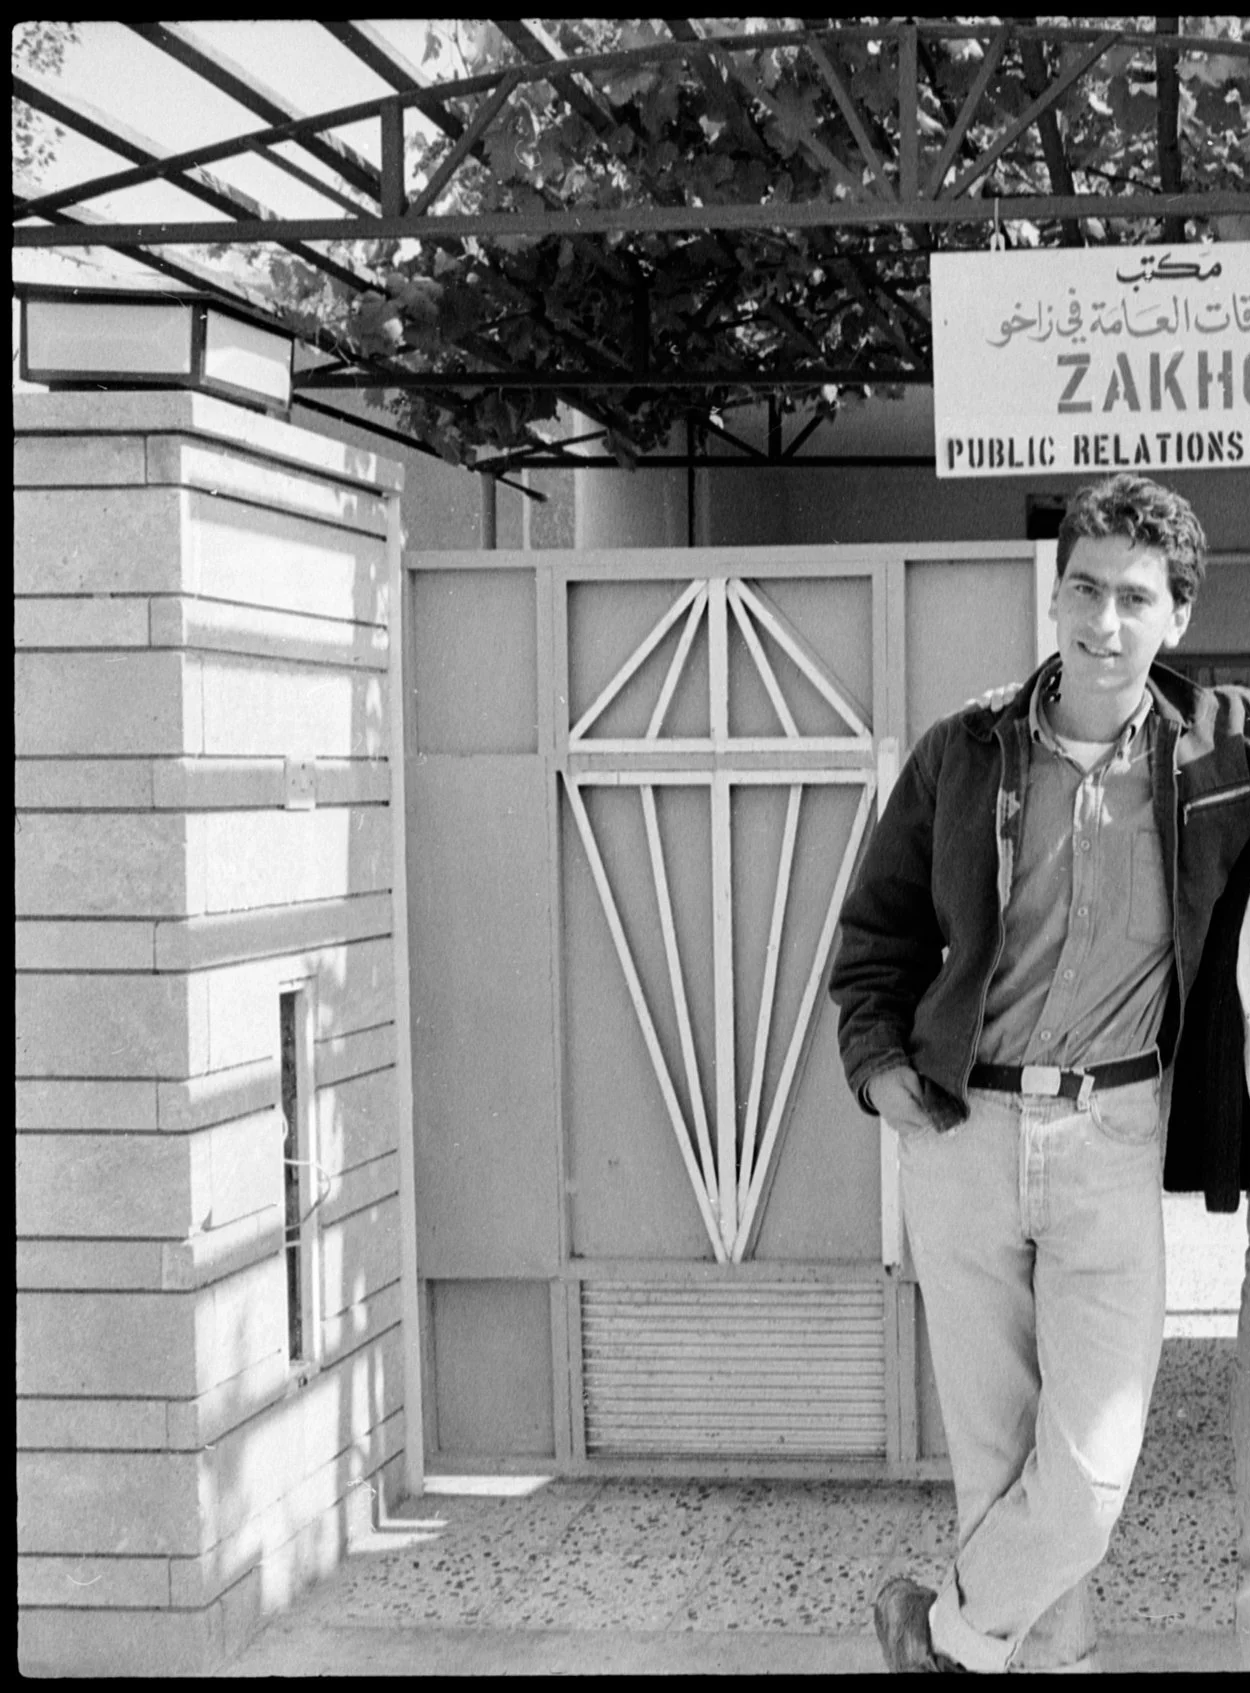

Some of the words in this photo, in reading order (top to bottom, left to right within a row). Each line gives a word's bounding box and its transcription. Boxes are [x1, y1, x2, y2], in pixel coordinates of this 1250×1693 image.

[1056, 288, 1084, 343] في
[947, 436, 1055, 469] PUBLIC
[1073, 430, 1244, 465] RELATIONS
